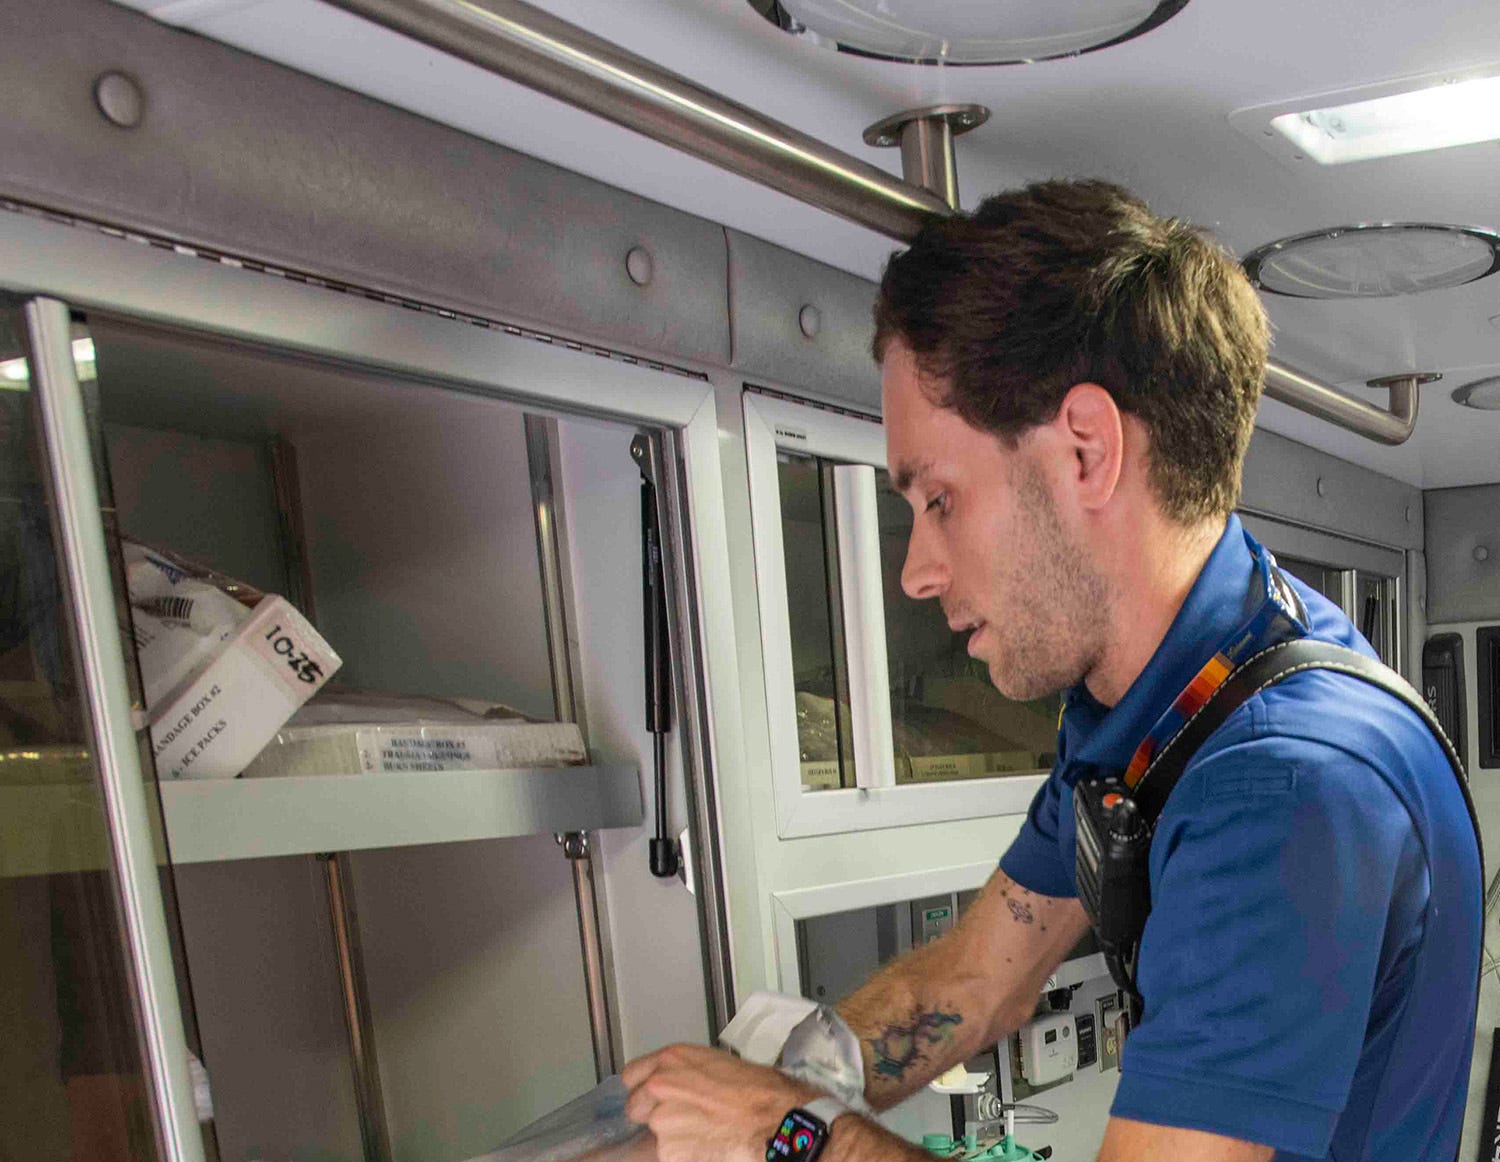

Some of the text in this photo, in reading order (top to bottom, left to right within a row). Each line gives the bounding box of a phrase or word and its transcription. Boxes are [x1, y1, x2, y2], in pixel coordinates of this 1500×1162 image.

[153, 713, 195, 759] ANDAGE
[191, 694, 213, 718] BOX
[181, 746, 201, 768] ICE
[198, 719, 228, 750] PACKS
